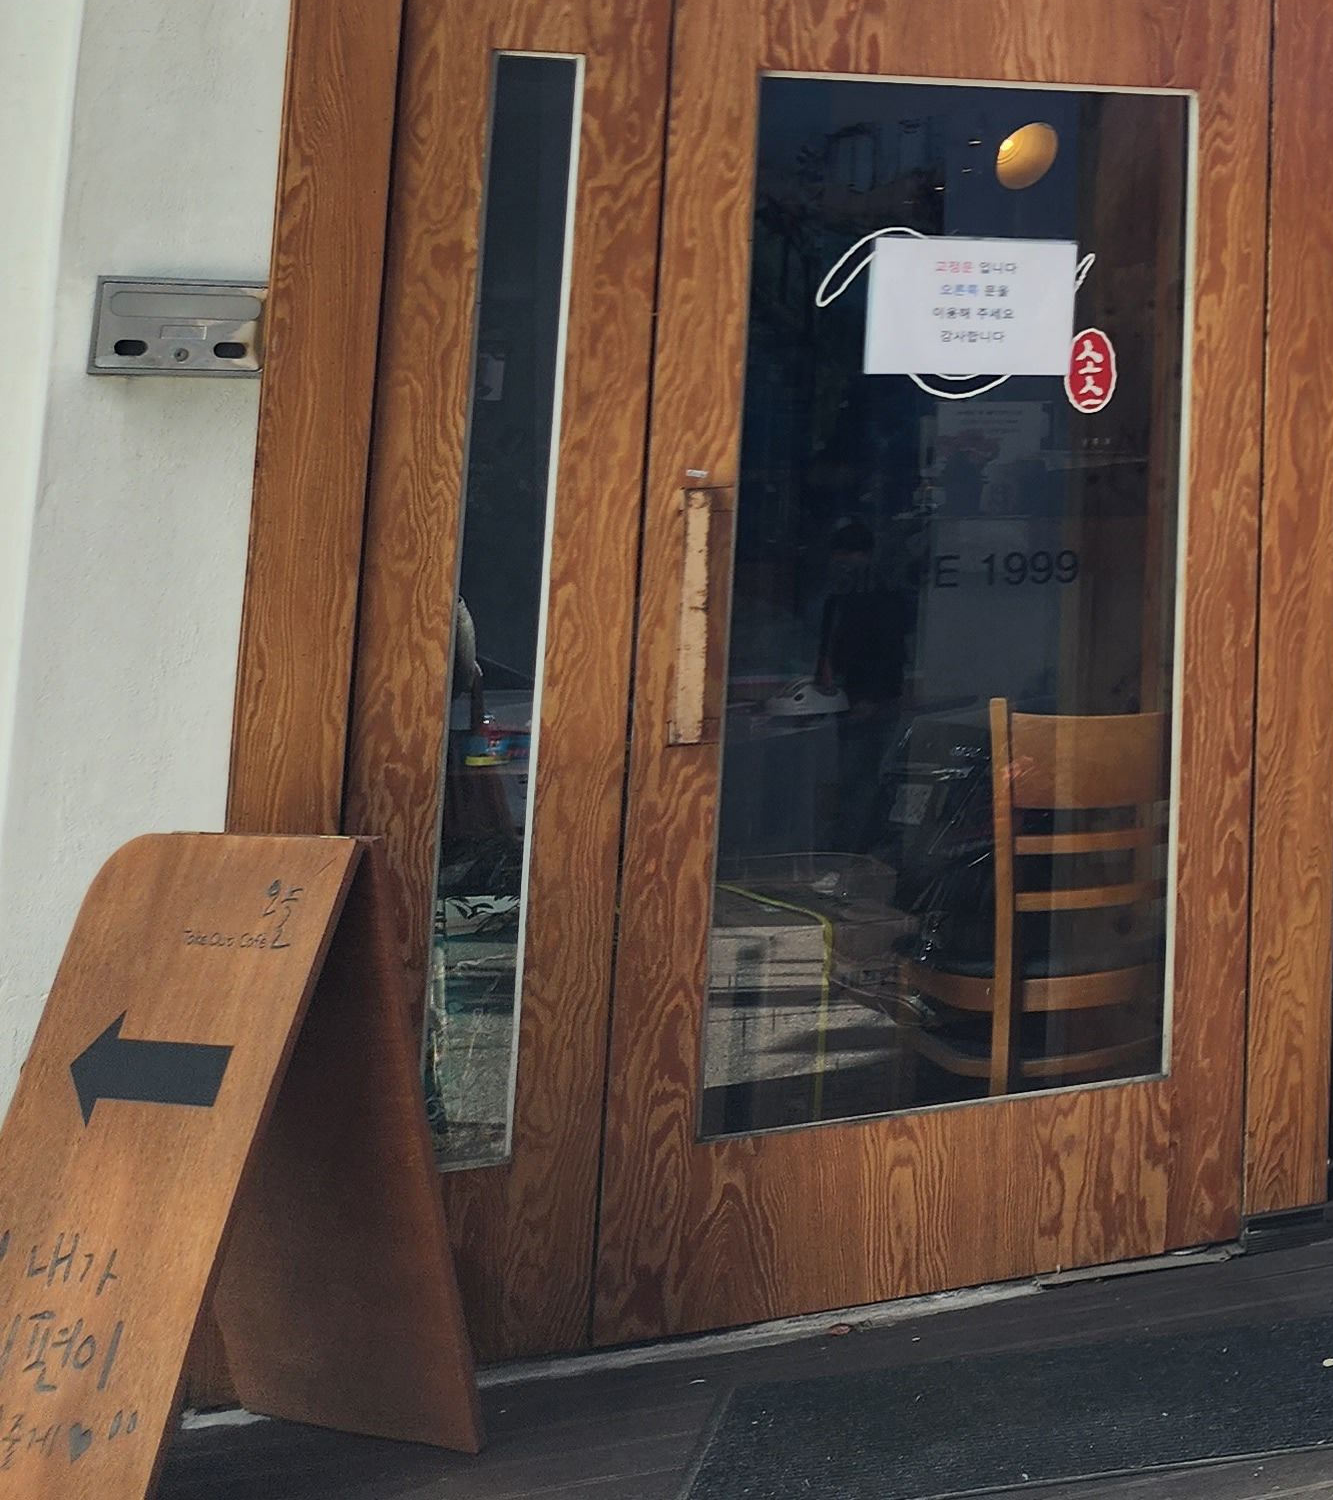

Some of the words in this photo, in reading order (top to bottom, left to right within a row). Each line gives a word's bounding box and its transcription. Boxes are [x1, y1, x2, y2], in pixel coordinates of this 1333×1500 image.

[935, 261, 973, 274] 고정문
[979, 262, 1017, 275] 입니다
[939, 284, 978, 297] 오른쪽
[932, 307, 971, 320] 이용해
[977, 307, 1015, 320] 주세요
[940, 330, 1005, 343] 감사합니다
[1075, 339, 1104, 406] 소스
[981, 549, 1078, 585] 1999
[26, 1231, 118, 1297] 내가
